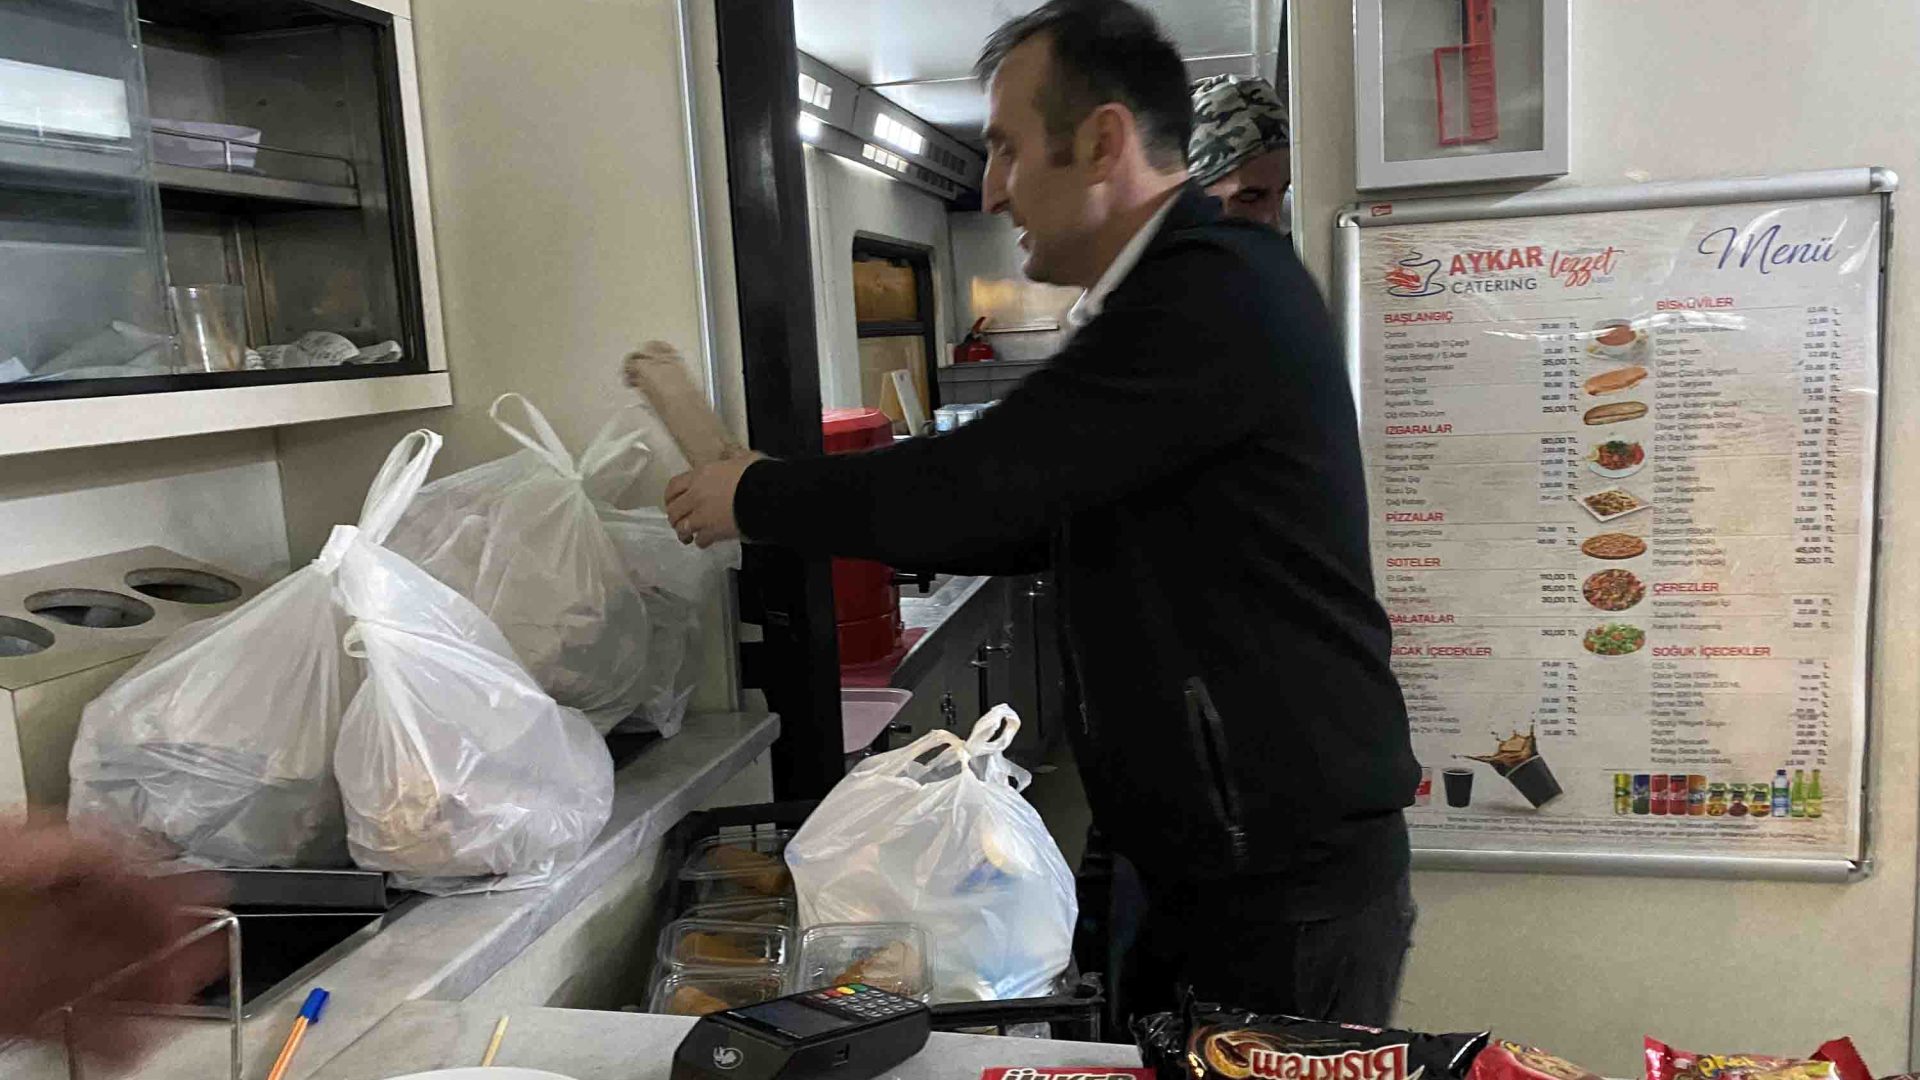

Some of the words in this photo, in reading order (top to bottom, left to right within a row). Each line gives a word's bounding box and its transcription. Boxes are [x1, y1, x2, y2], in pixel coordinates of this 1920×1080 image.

[1698, 224, 1838, 274] Menü
[1450, 246, 1543, 276] AYKAR
[1550, 246, 1625, 287] lezzet
[1452, 278, 1537, 294] CATERING
[1384, 311, 1454, 324] BAŞLANGIÇ
[1386, 512, 1444, 522] PİZZALAR
[1386, 558, 1440, 568] SOTELER
[1653, 583, 1719, 595] ÇEREZLER
[1388, 615, 1454, 623] SALATALAR
[1428, 647, 1492, 658] İÇECEKLER
[1653, 645, 1695, 656] SOĞUK
